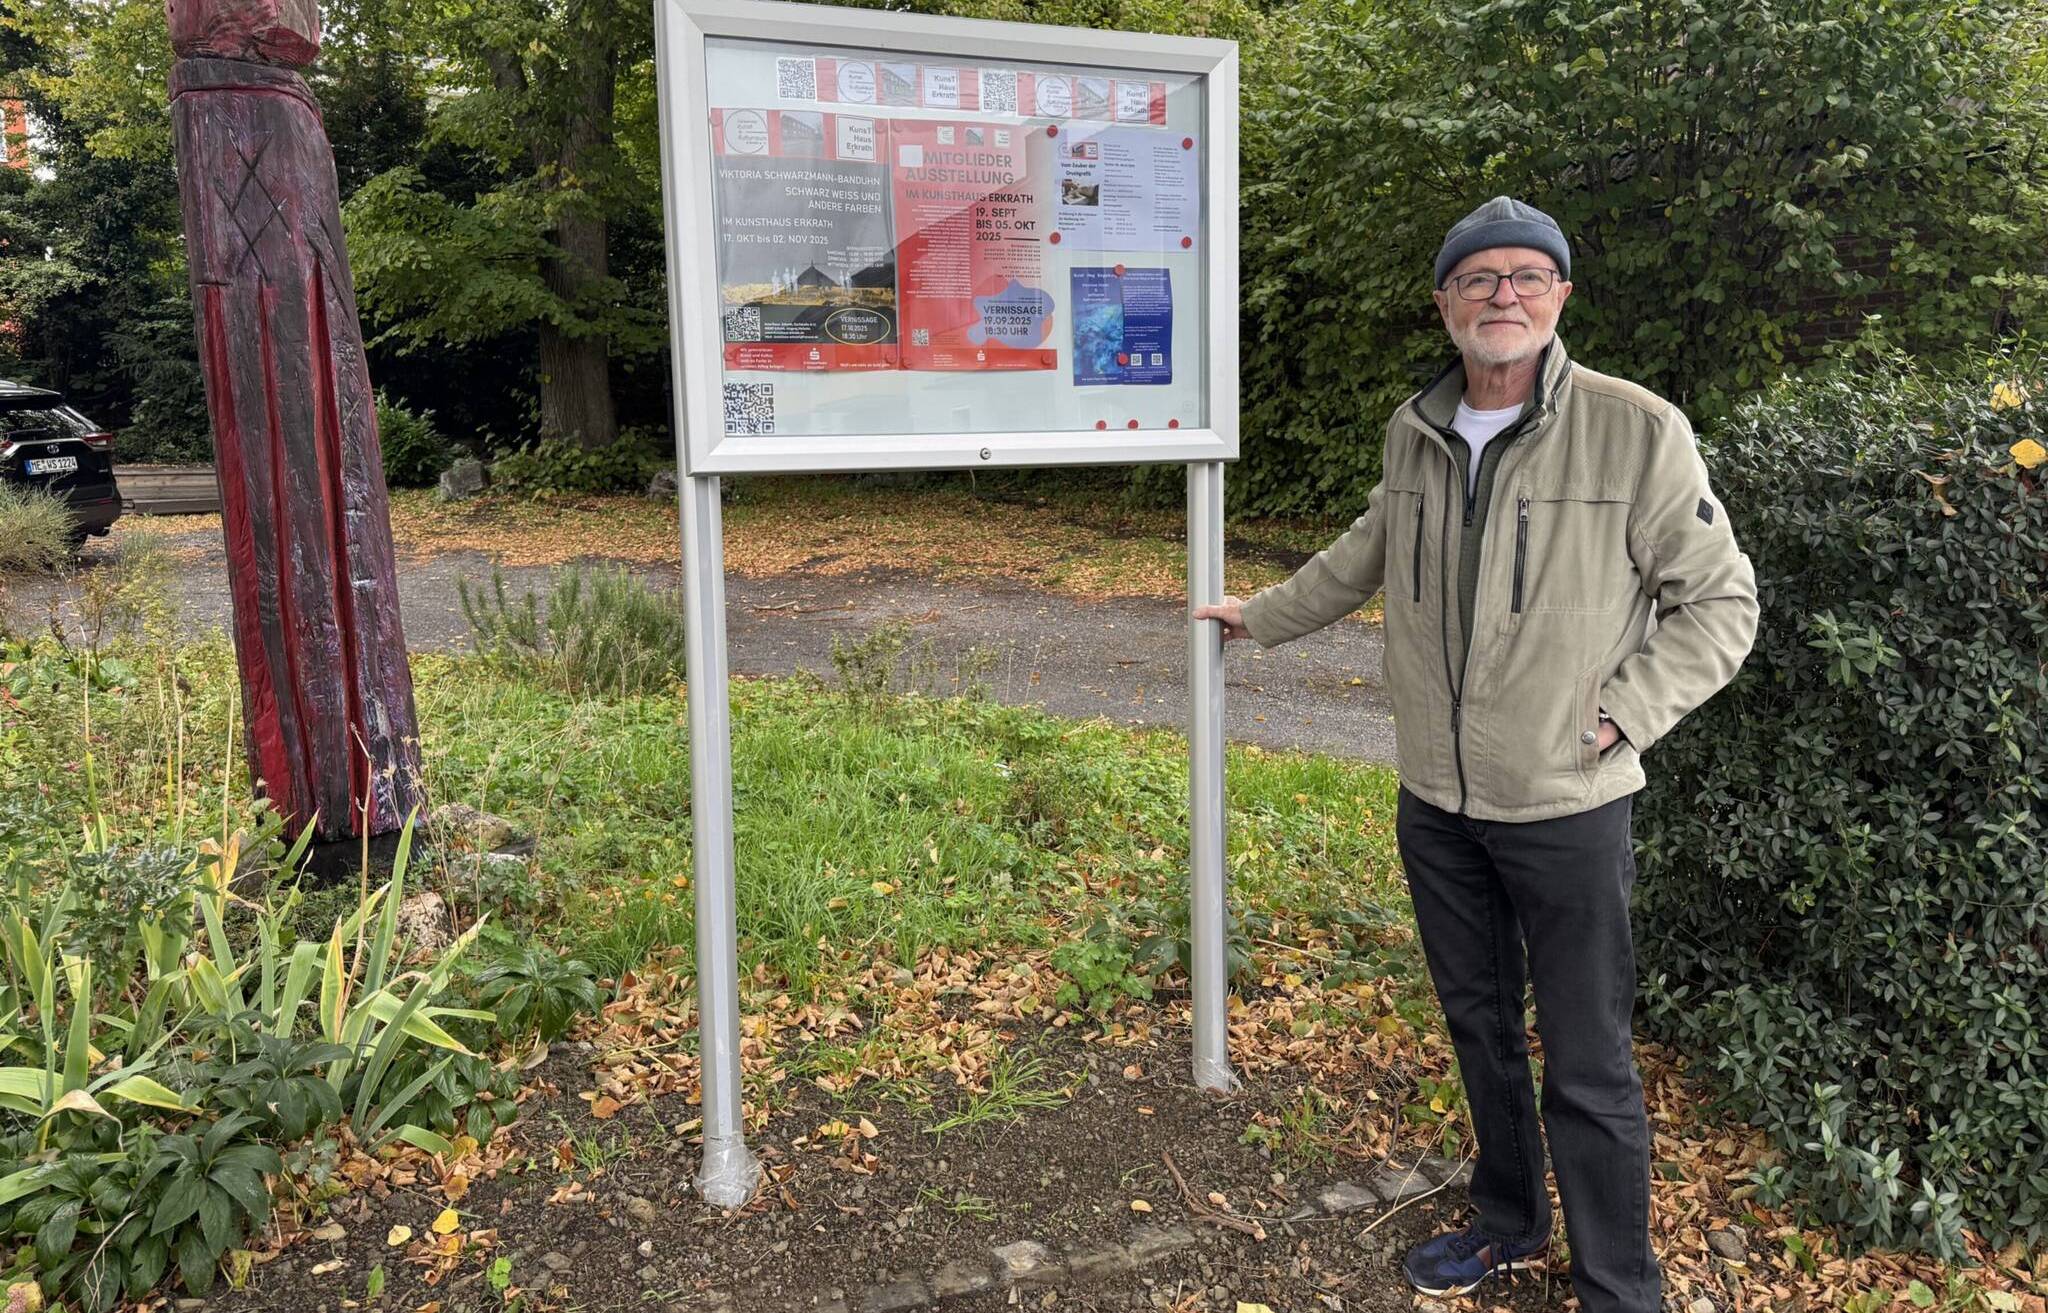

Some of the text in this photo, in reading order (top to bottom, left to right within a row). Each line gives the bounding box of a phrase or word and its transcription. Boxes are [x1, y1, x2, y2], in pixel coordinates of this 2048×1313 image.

[849, 125, 872, 135] KunsT
[853, 135, 872, 144] Haus
[846, 143, 873, 152] Erkrath
[923, 151, 1012, 168] MITGLIEDER
[719, 169, 881, 186] VIKTORIA SCHWARZMANN-BANDUHN
[905, 169, 1014, 185] AUSSTELLUNG
[785, 186, 881, 201] SCHWARZ WEISS UND
[905, 189, 1033, 204] IM KUNSTHAUS ERKRATH
[808, 200, 881, 214] ANDERE FARBEN
[975, 208, 1017, 218] 19. SEPT
[722, 217, 833, 228] IM KUNSTHAUS ERKRATH
[976, 220, 1036, 230] BIS 05. OKT
[723, 233, 829, 245] 17. OKT bis 02. NOV 2025
[975, 232, 1001, 241] 2025
[983, 305, 1043, 315] VERNISSAGE
[840, 315, 878, 324] VERNISSAGE
[983, 316, 1032, 326] 19.09.2025
[984, 326, 1029, 336] 18:30 UHR
